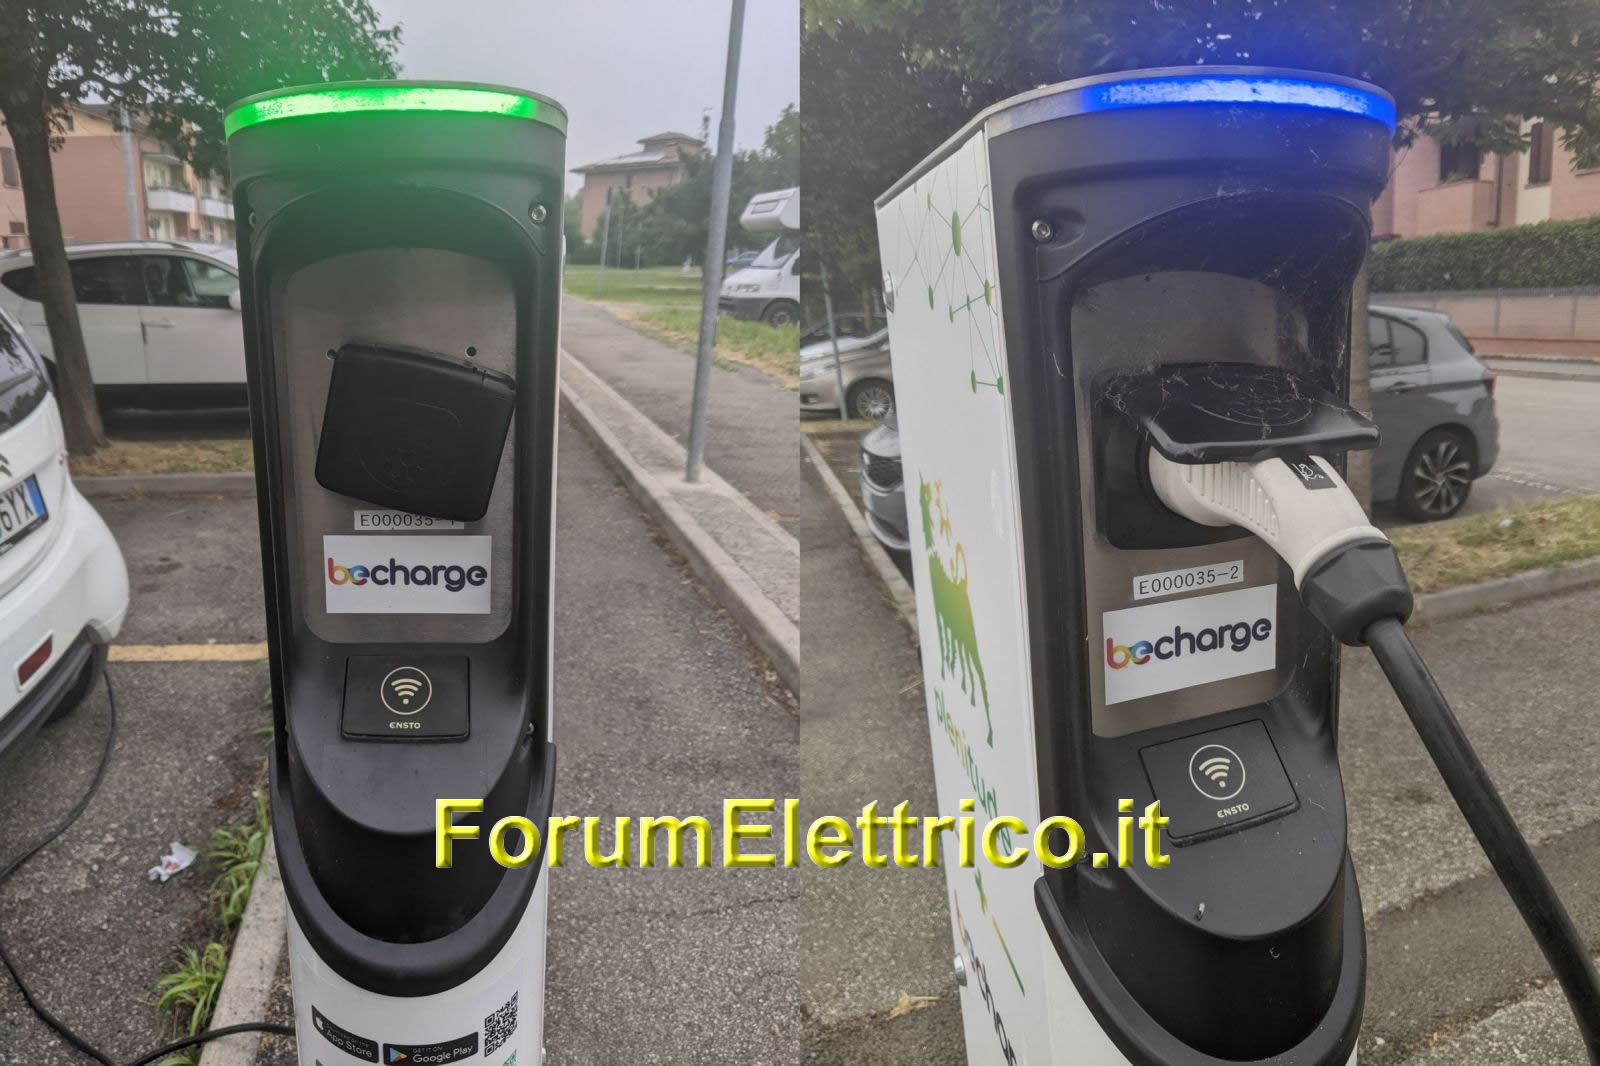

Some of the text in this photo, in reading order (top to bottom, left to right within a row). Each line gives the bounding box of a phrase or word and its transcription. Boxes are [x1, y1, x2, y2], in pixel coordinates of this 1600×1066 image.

[327, 557, 488, 592] becharge
[1138, 564, 1240, 595] E000035-2
[1105, 617, 1272, 669] becharge
[389, 721, 421, 729] ENSTO
[1216, 802, 1250, 818] ENSTO
[326, 1029, 344, 1047] App
[345, 1040, 373, 1058] Store
[412, 1044, 474, 1063] Google Play
